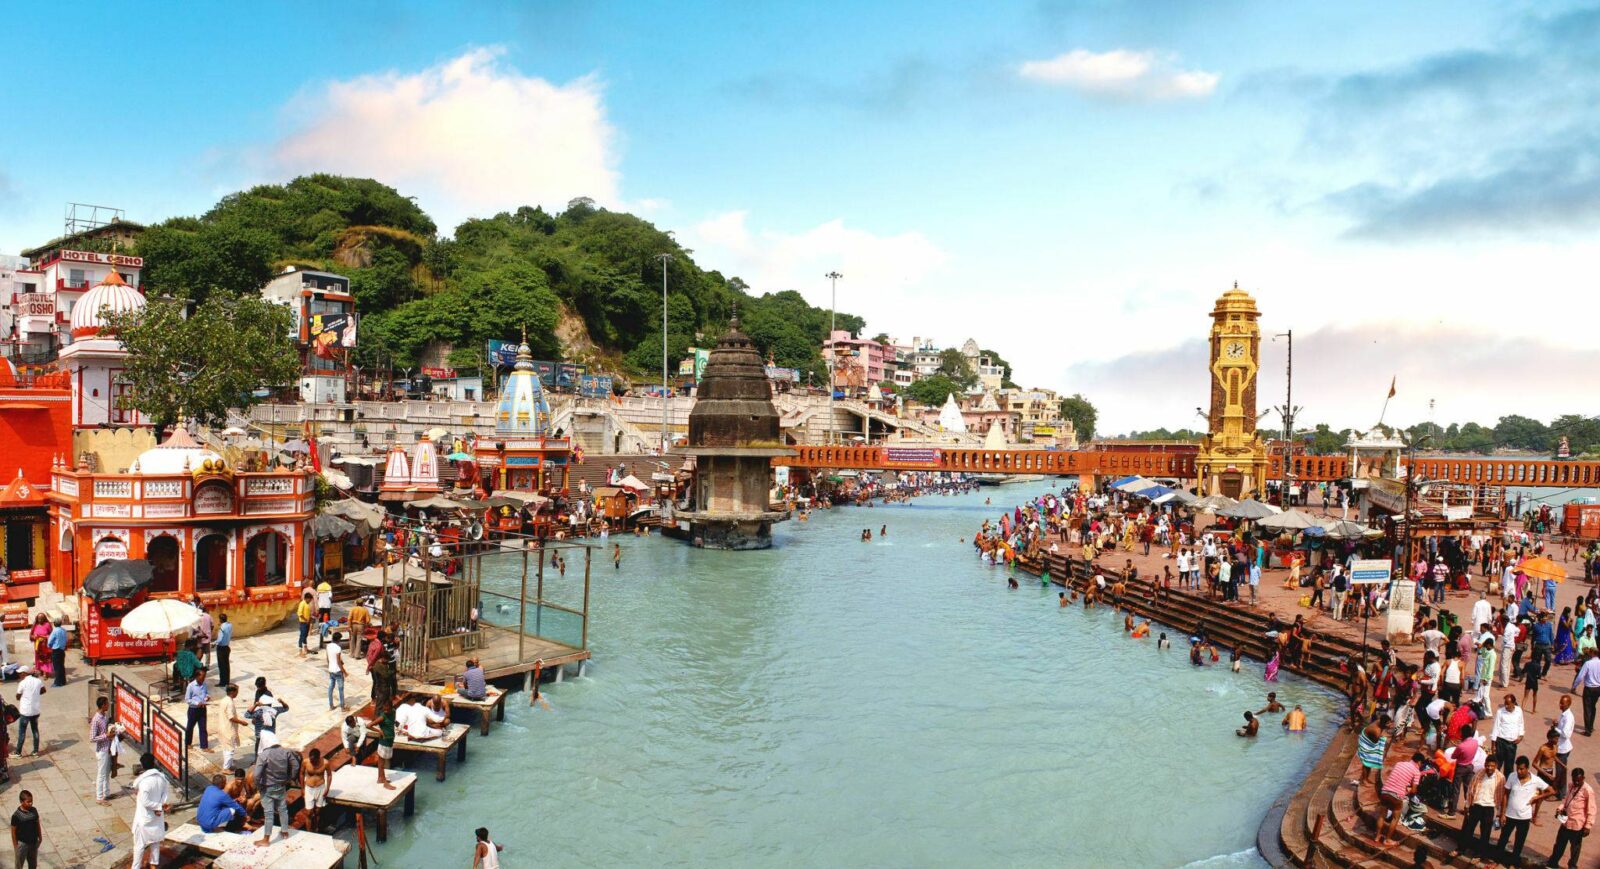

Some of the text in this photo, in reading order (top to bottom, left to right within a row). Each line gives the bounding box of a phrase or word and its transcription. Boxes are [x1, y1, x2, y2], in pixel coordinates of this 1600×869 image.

[63, 250, 142, 265] HOTEL OSHO
[30, 293, 54, 303] HOTEL
[30, 303, 54, 314] OSHO
